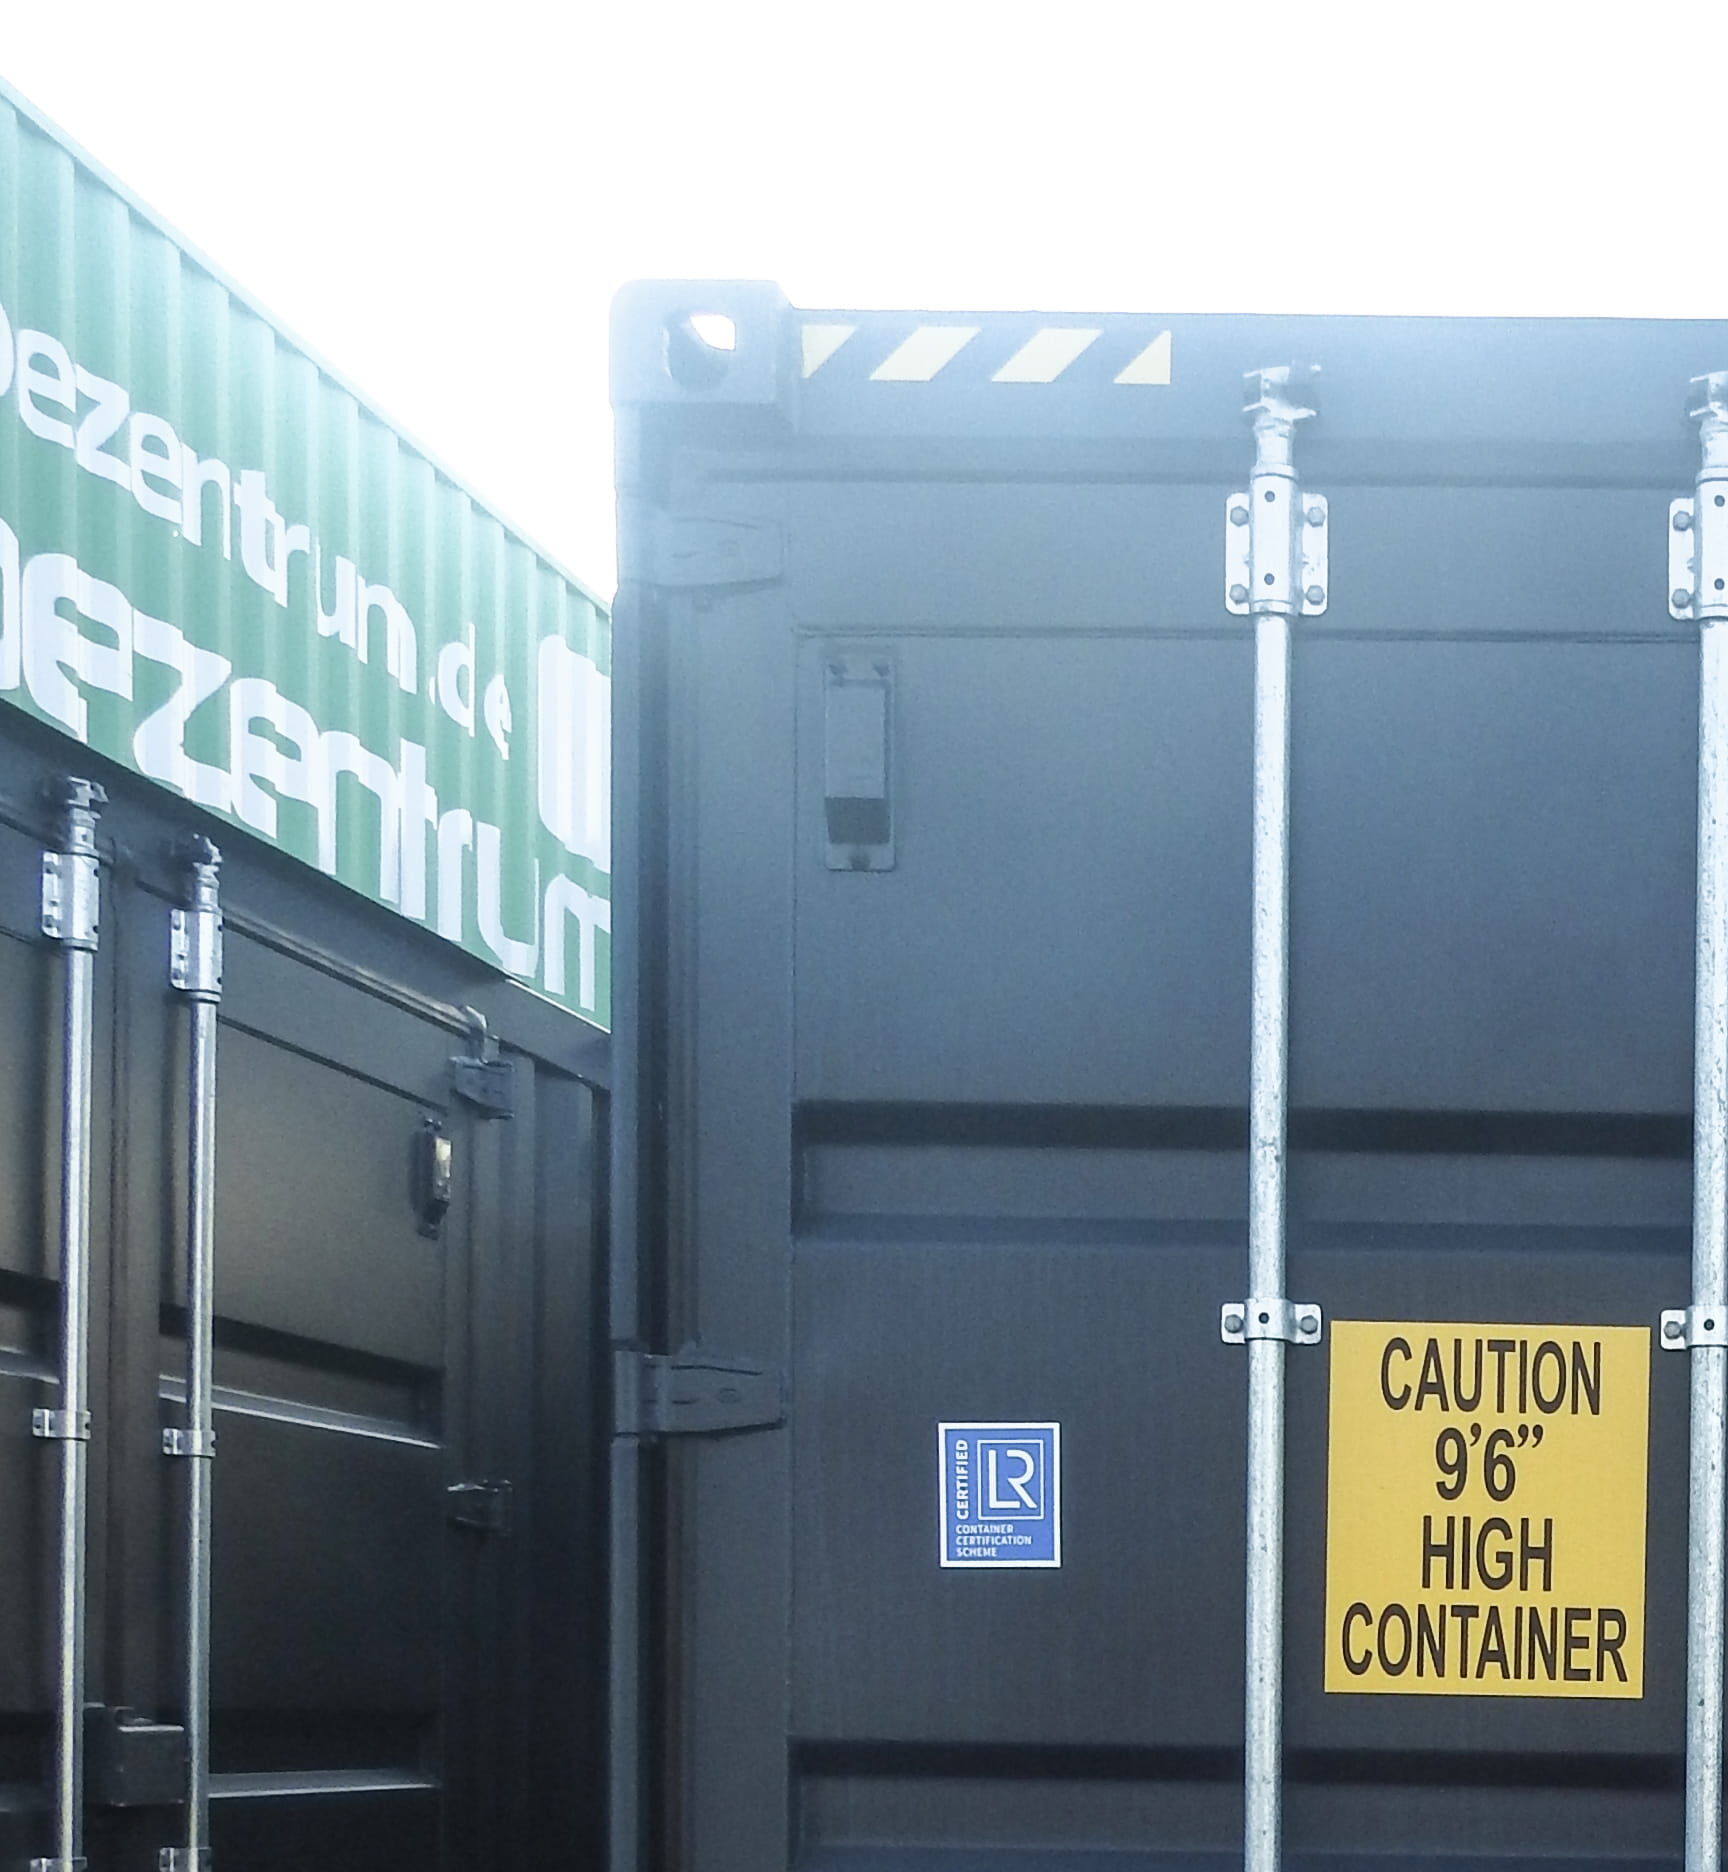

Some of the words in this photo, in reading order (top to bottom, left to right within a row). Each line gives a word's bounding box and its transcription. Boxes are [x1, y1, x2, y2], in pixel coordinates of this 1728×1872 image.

[1381, 1337, 1600, 1415] CAUTION
[956, 1440, 968, 1519] CERTIFIED
[989, 1450, 1037, 1508] LR
[956, 1524, 1013, 1534] CONTAINER
[956, 1535, 1031, 1545] CERTIFICATION
[957, 1547, 997, 1557] SCHEME
[1422, 1516, 1552, 1591] HIGH
[1342, 1602, 1627, 1682] CONTAINER
